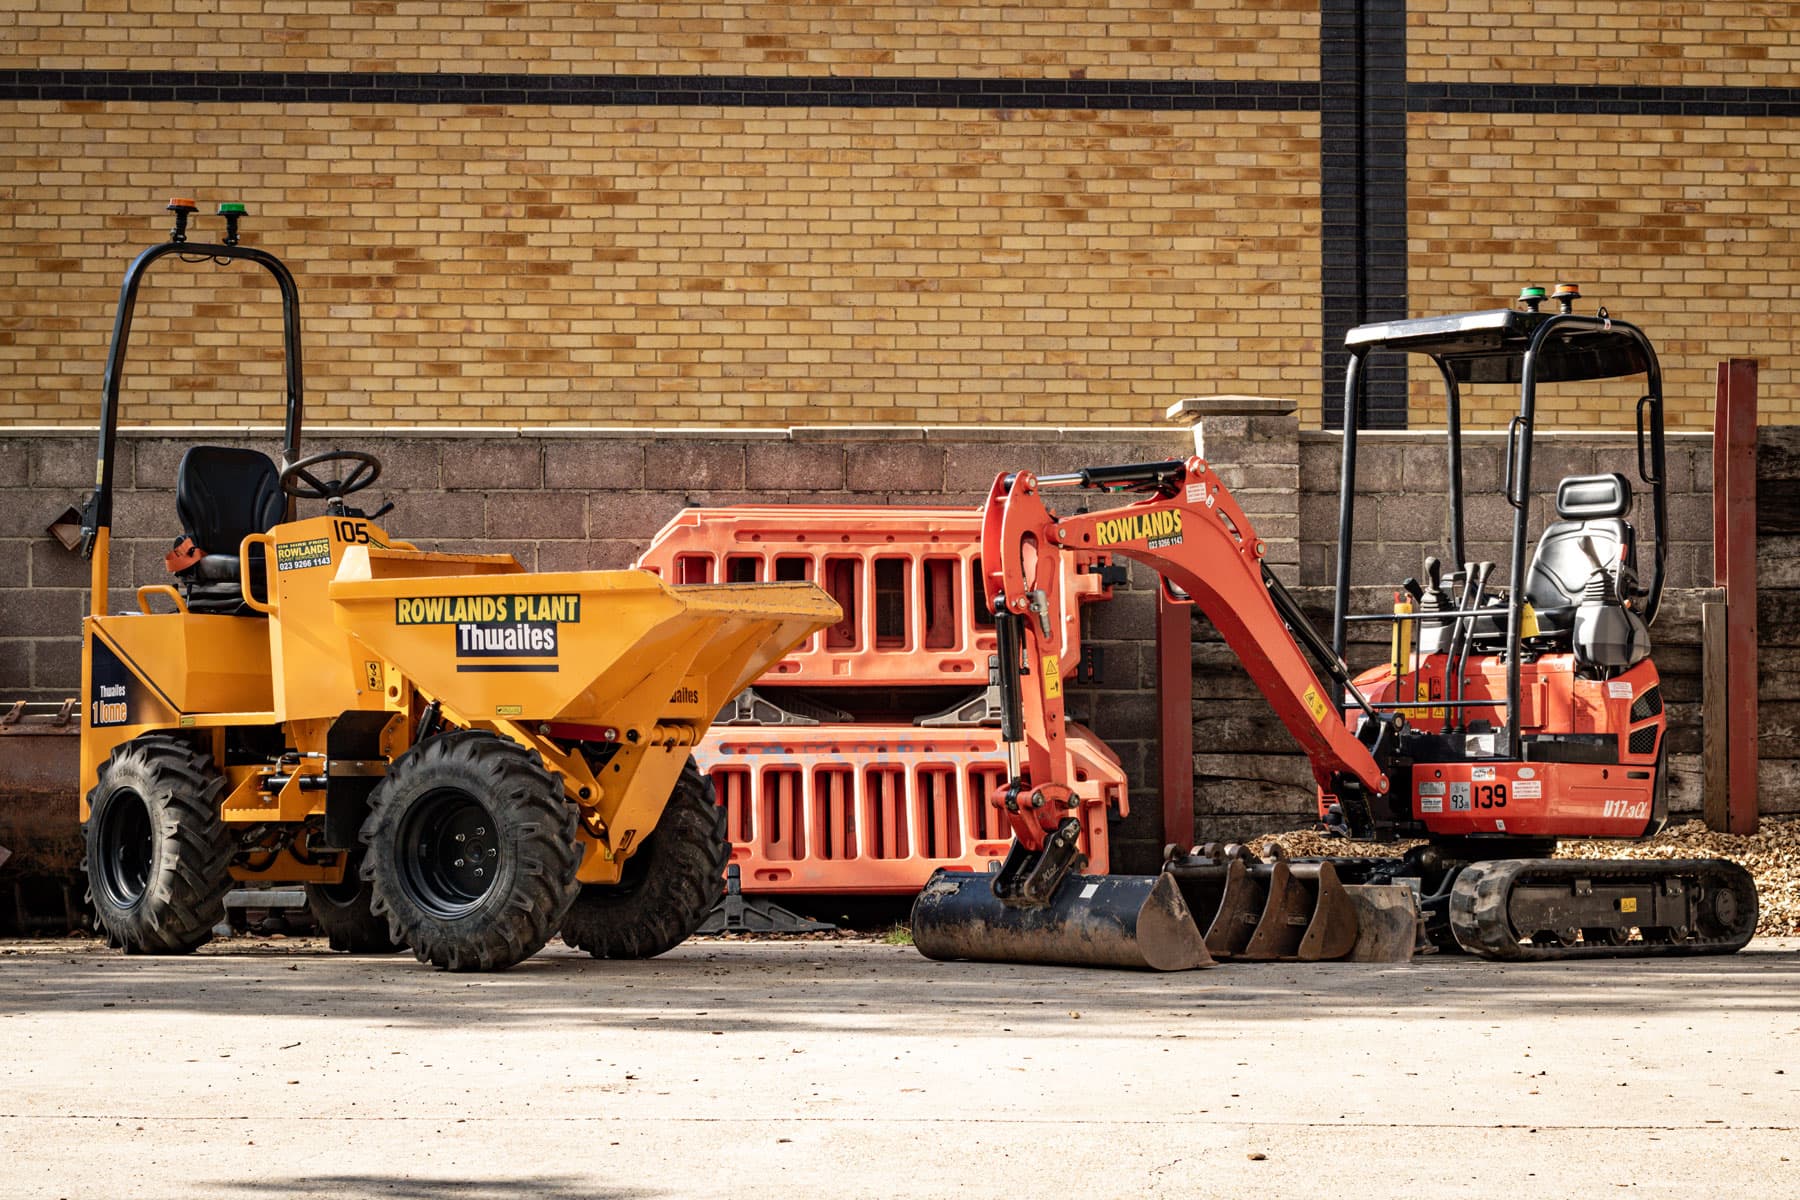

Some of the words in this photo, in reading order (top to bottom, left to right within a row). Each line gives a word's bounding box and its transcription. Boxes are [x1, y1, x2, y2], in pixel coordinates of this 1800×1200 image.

[333, 519, 370, 544] 105
[1096, 509, 1182, 545] ROWLANDS
[279, 544, 329, 558] ROWLANDS
[280, 562, 293, 570] 023
[294, 559, 312, 569] 9266
[313, 556, 331, 567] 1143
[398, 597, 507, 623] ROWLANDS
[515, 596, 578, 622] PLANT
[459, 624, 555, 651] Thwaites
[100, 684, 125, 697] Thwaites
[92, 701, 99, 724] 1
[1451, 794, 1464, 809] 93
[1474, 784, 1507, 809] 139
